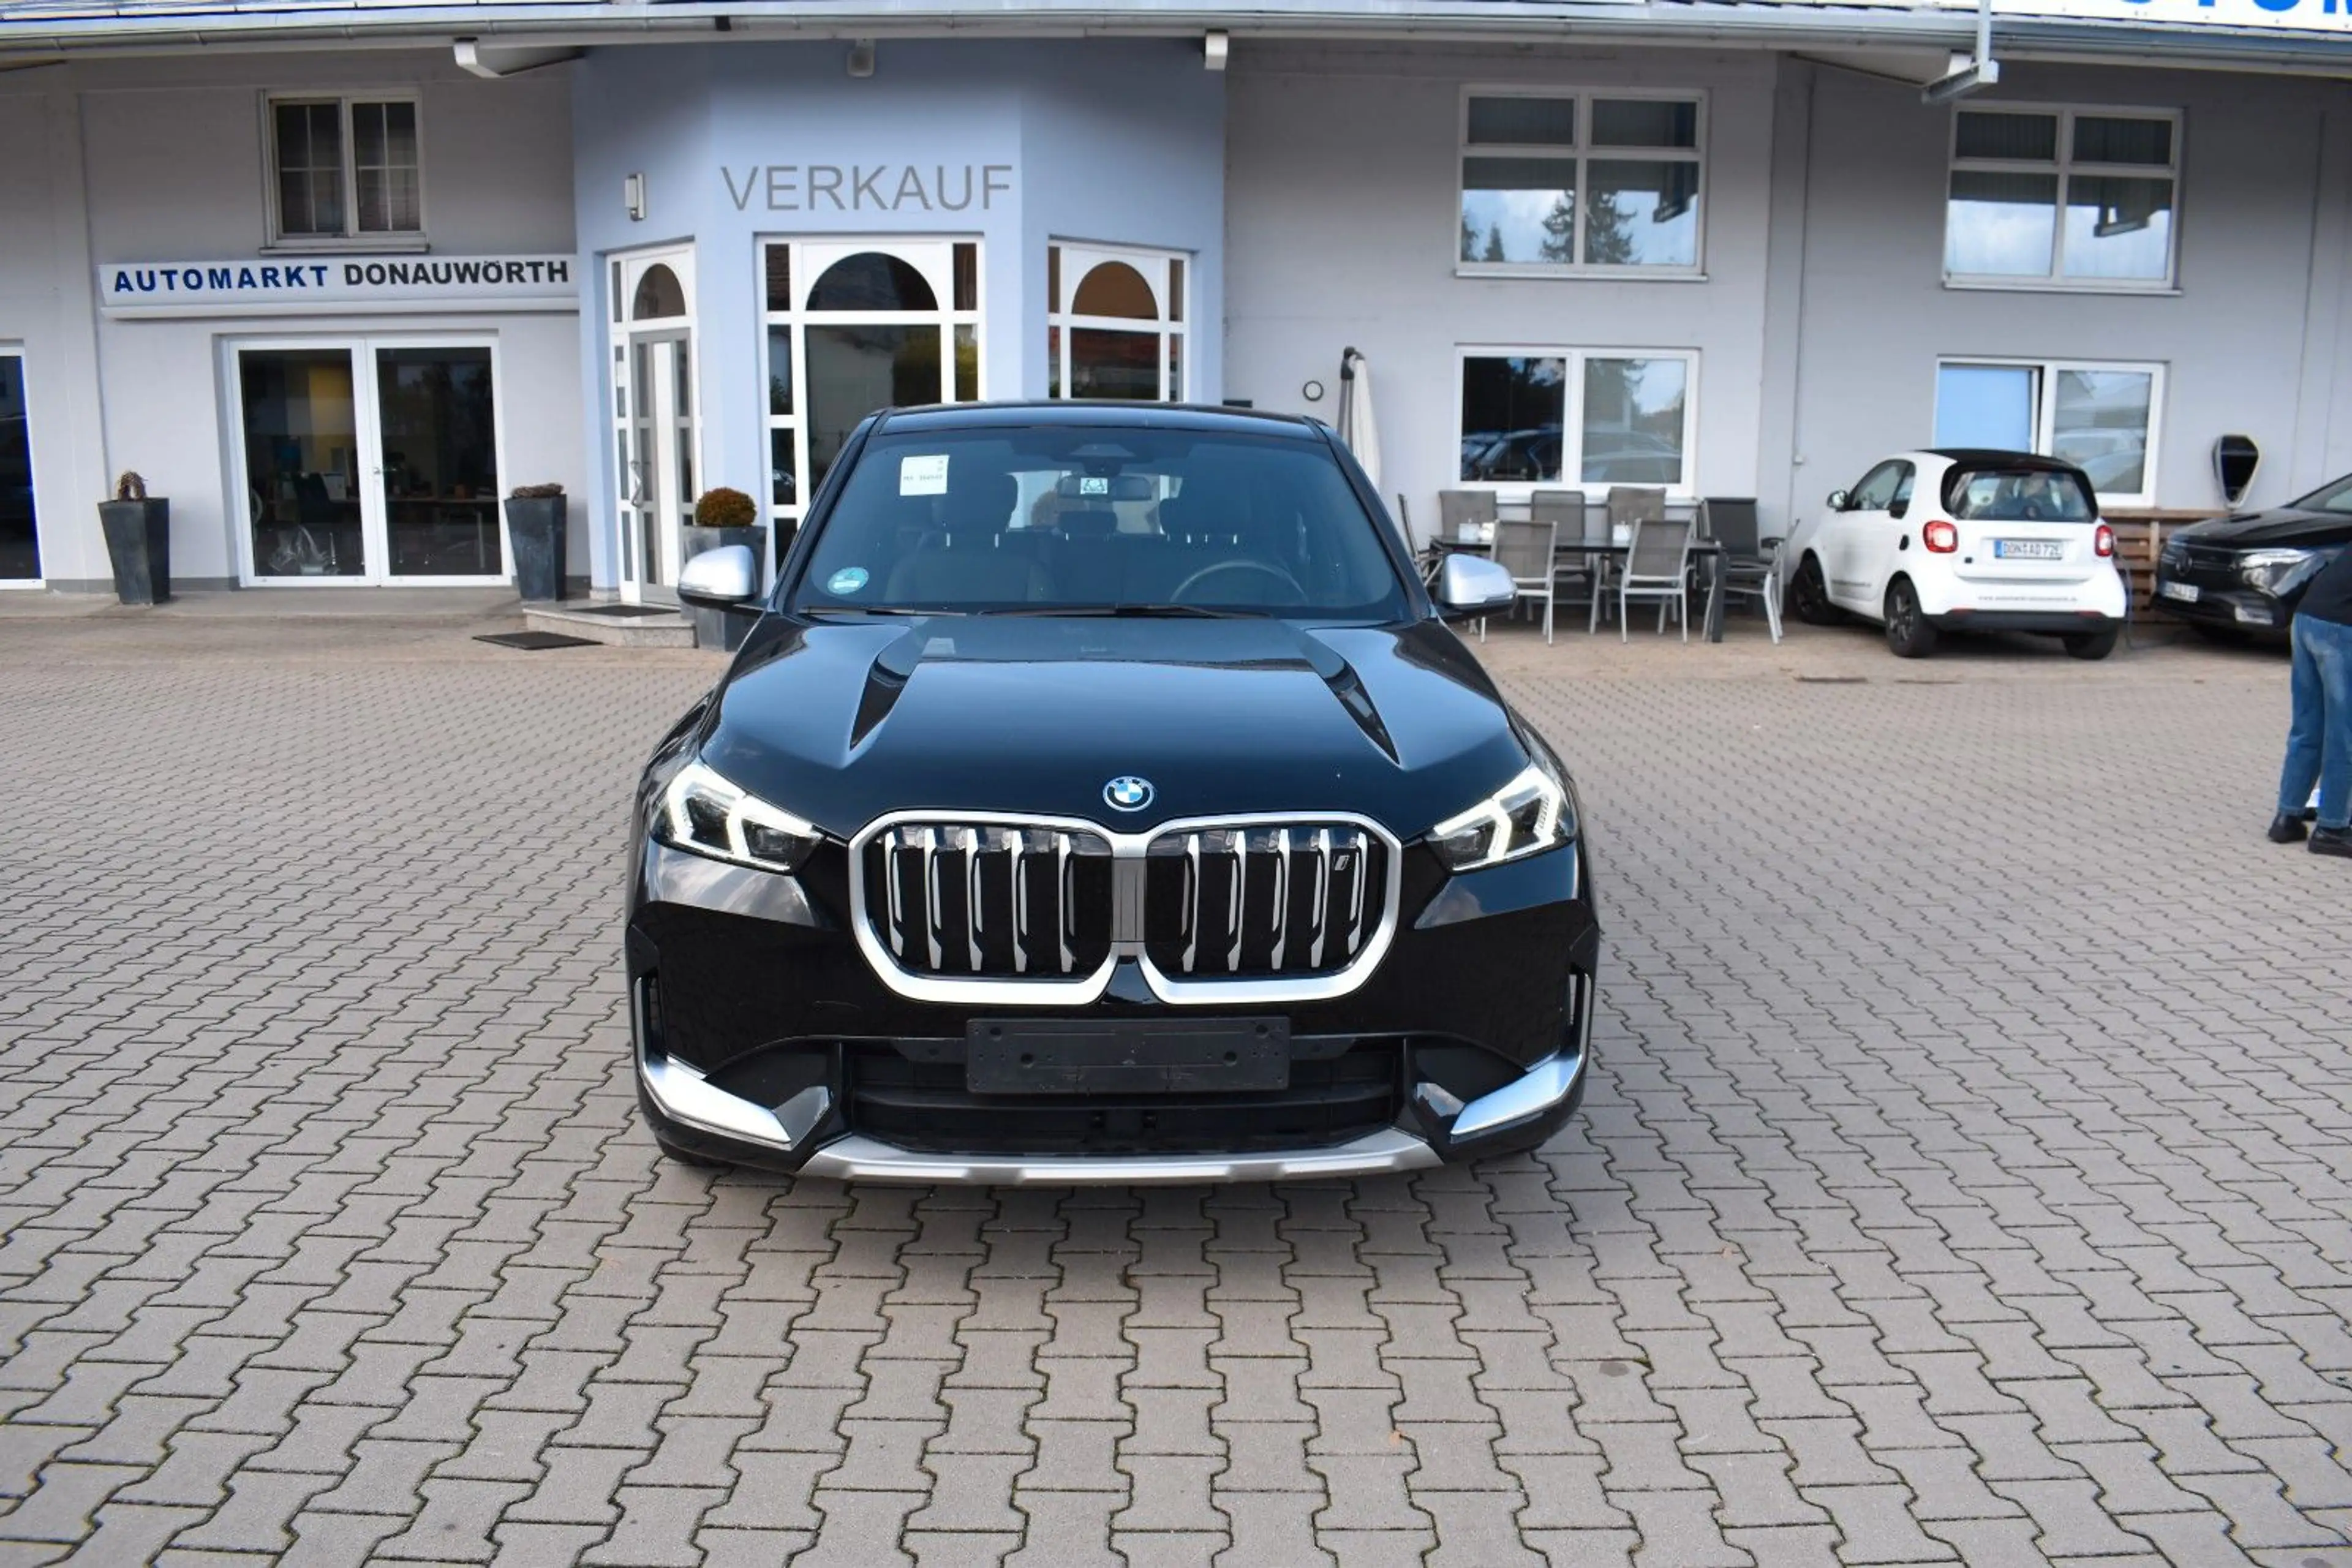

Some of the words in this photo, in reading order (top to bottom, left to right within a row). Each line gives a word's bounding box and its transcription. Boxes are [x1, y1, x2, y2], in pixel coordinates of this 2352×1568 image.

[720, 165, 1012, 211] VERKAUF
[114, 265, 328, 292] AUTOMARKT
[344, 260, 569, 285] DONAUWÖRTH
